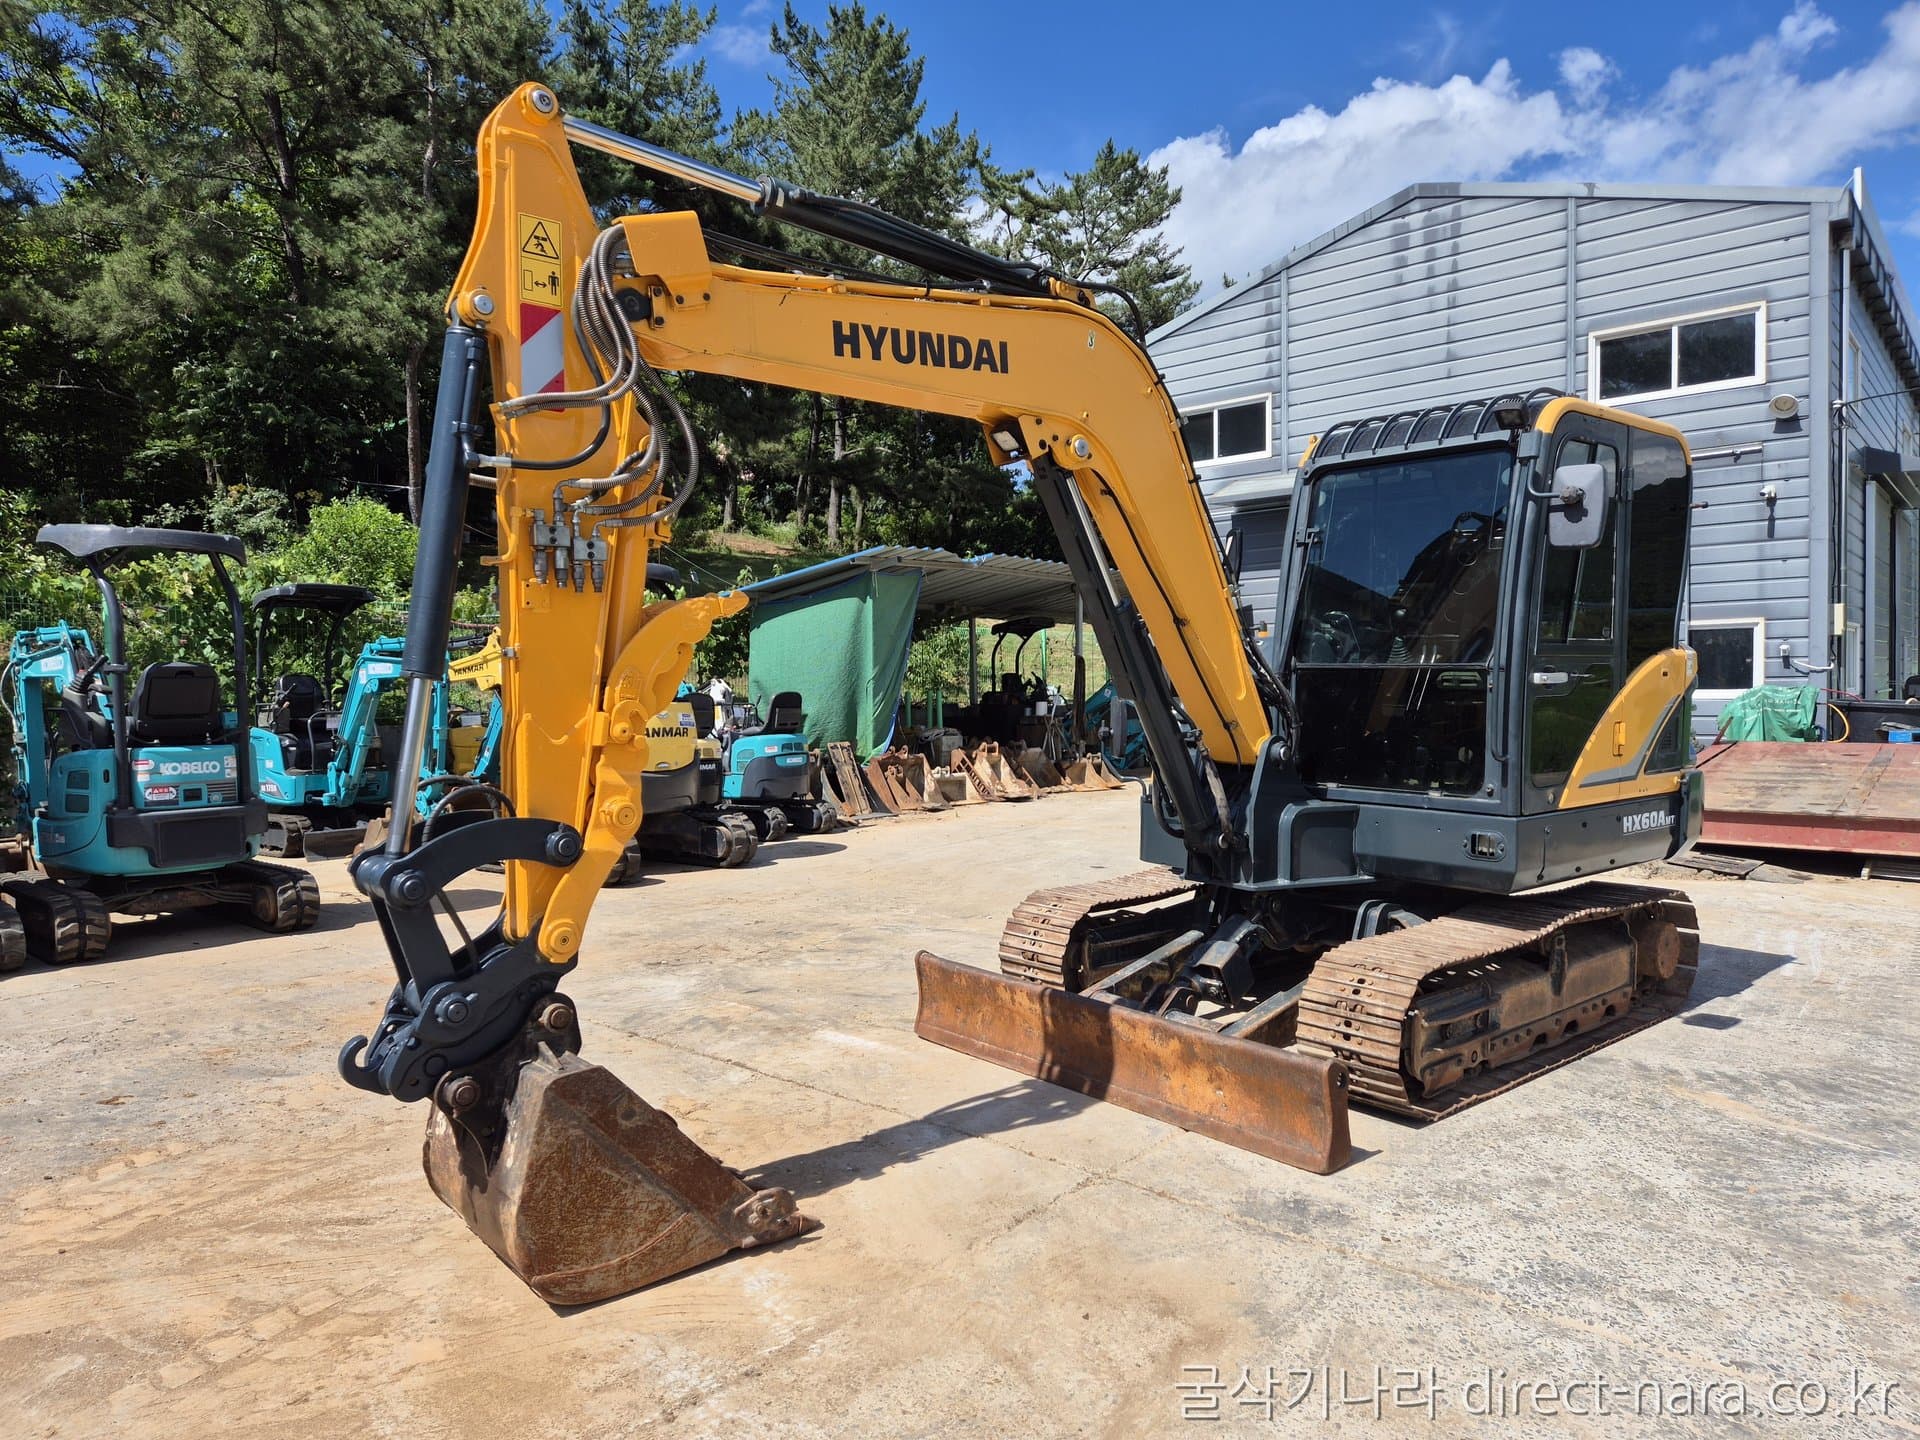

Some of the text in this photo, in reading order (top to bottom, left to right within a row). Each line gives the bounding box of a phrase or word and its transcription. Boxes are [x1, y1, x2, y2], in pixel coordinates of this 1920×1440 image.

[832, 320, 1009, 374] HYUNDAI
[645, 726, 688, 738] ANMAR
[160, 761, 220, 776] KOBELCO
